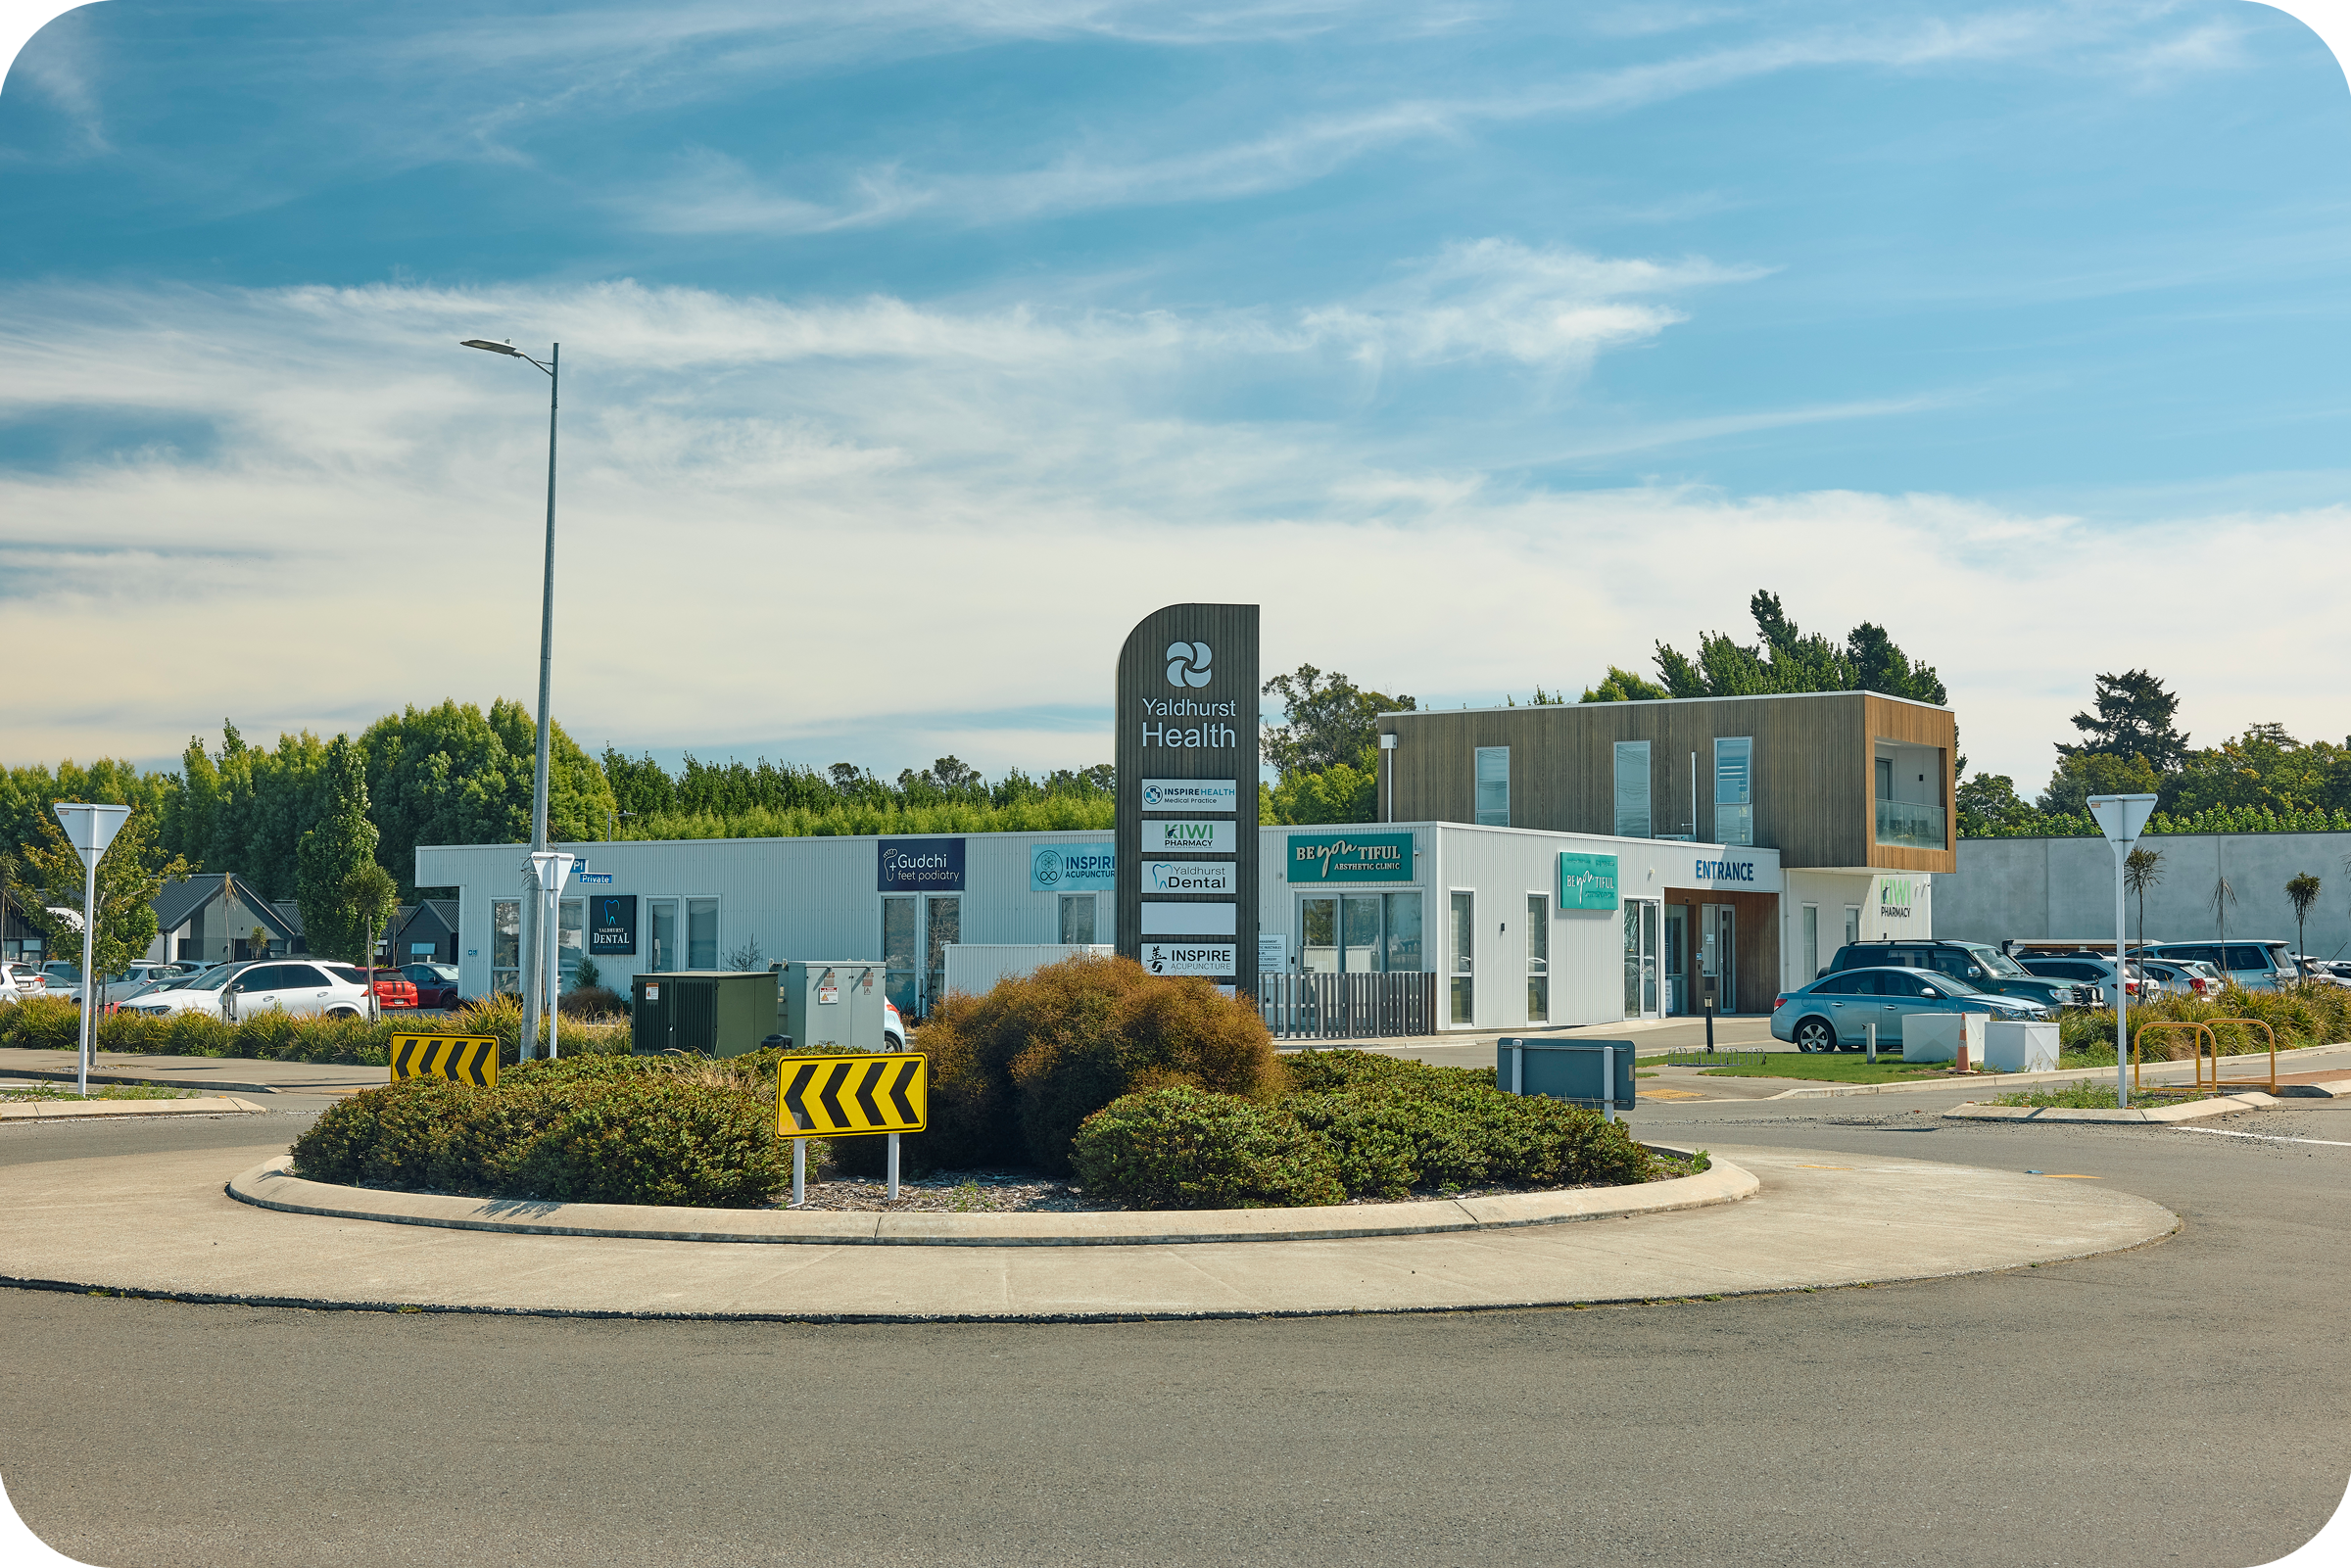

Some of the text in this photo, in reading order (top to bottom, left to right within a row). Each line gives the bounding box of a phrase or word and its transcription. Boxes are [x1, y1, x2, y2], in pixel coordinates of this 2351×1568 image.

[1142, 697, 1236, 716] Yaldhurst
[1142, 722, 1236, 748] Health
[1165, 824, 1214, 839] KIWI
[897, 853, 948, 869] Gudchi
[1375, 862, 1401, 871] CLINIC
[897, 870, 960, 882] feet podiatry
[1065, 870, 1115, 879] ACUPUNCTUR
[1173, 866, 1225, 876] Yaldhurst
[1696, 859, 1754, 881] ENTRANCE
[582, 874, 609, 883] Private
[1168, 877, 1226, 888] Dental
[1881, 879, 1911, 906] KIWI
[1881, 906, 1911, 918] PHARMACY
[593, 932, 630, 944] DENTAL
[1171, 949, 1231, 962] INSPIRE
